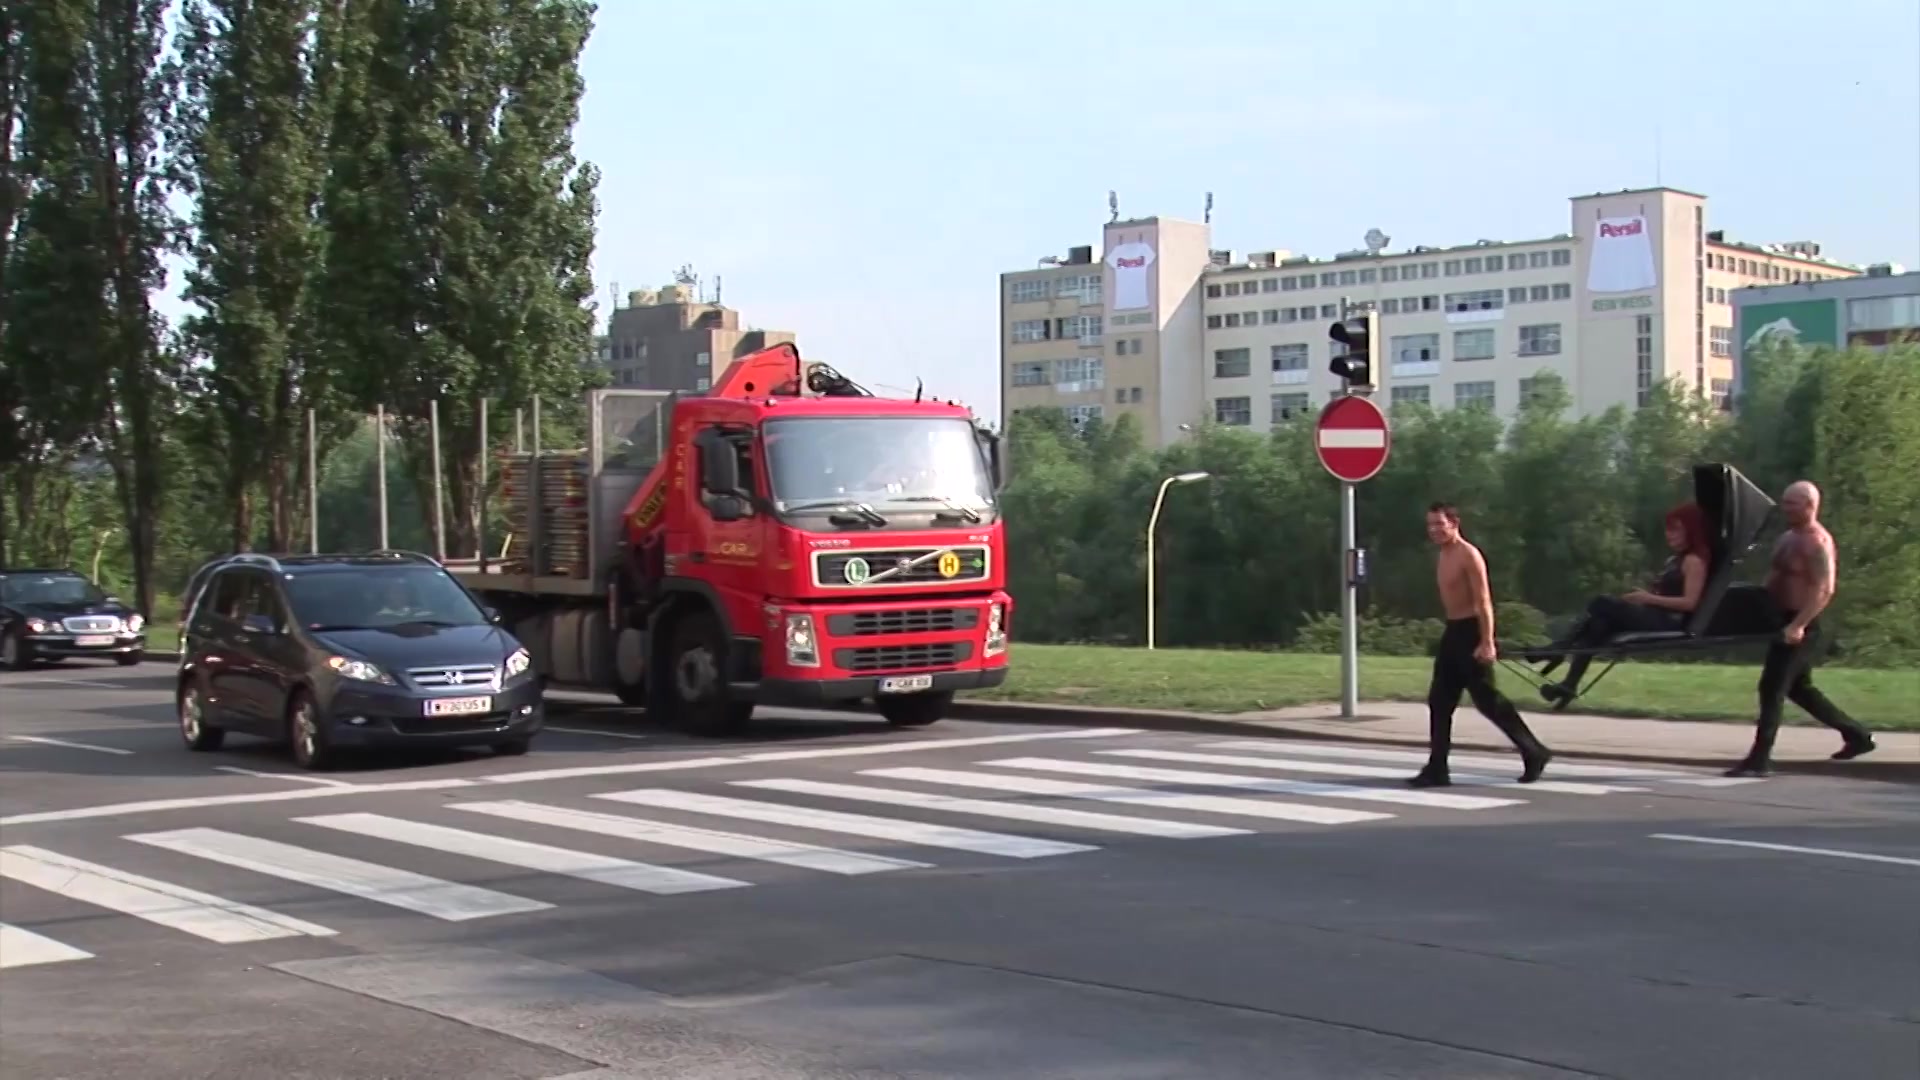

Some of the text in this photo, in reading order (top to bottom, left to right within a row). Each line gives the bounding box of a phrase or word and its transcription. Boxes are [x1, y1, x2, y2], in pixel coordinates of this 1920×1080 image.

[1600, 219, 1642, 238] Persil
[849, 562, 863, 581] L
[944, 558, 955, 572] H
